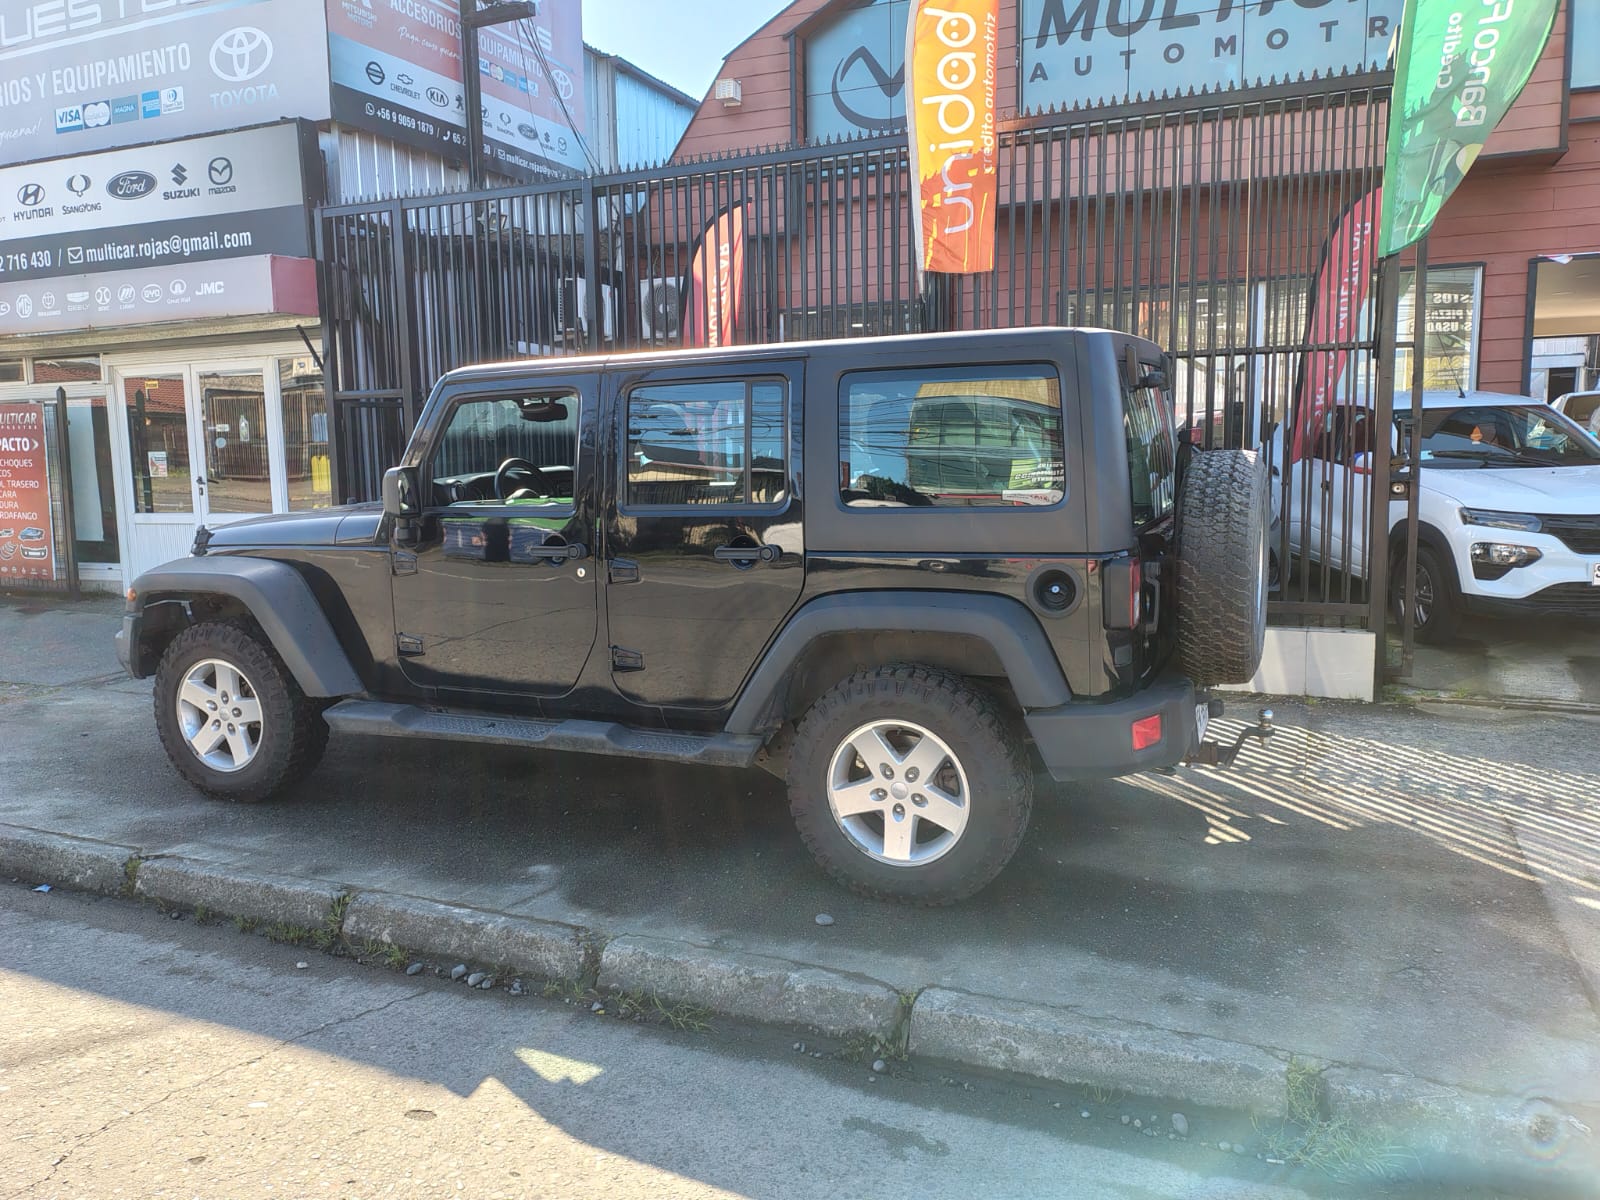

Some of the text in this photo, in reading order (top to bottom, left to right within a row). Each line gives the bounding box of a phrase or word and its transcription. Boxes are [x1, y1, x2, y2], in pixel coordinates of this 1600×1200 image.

[982, 12, 996, 108] automotriz
[35, 73, 47, 99] Y
[52, 41, 191, 96] EQUIPAMIENTO
[209, 83, 279, 111] TOYOTA
[390, 83, 421, 101] CHEVROLET
[429, 90, 446, 108] KIA
[58, 110, 81, 124] VISA
[376, 107, 391, 121] +56
[398, 114, 416, 129] 9059
[417, 120, 434, 136] 1879
[922, 7, 977, 234] unidad
[117, 175, 146, 195] Ford
[163, 187, 201, 201] SUZUKI
[13, 206, 54, 222] HYUNDAI
[6, 252, 28, 272] 716
[30, 249, 52, 269] 430
[86, 230, 253, 263] multicar.rojas@gmail.com
[195, 281, 225, 297] JMC
[0, 412, 37, 425] ULTICAR
[0, 437, 30, 452] ACTO
[7, 480, 39, 489] TRASERO
